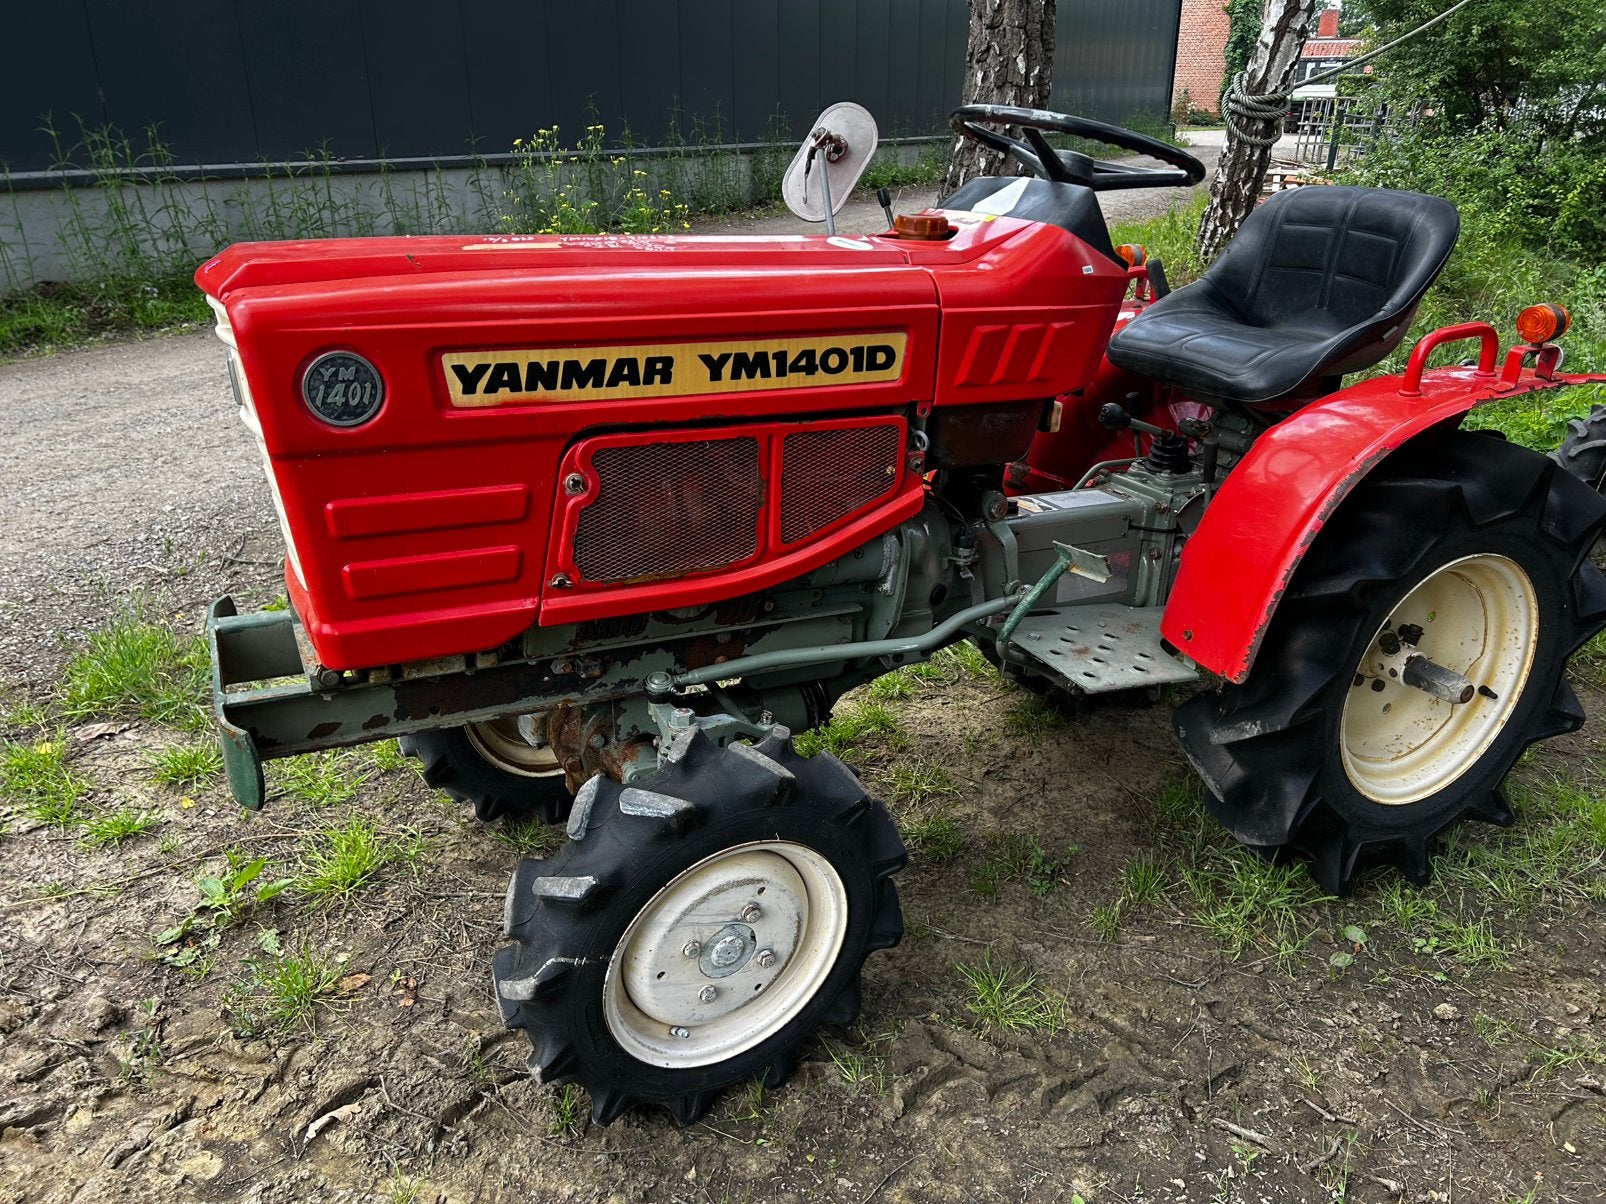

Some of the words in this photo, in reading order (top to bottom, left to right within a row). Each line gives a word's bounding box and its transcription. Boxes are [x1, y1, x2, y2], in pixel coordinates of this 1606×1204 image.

[319, 366, 355, 381] YM
[451, 356, 675, 394] YANMAR
[698, 345, 896, 382] YM1401D
[315, 381, 372, 407] 1401
